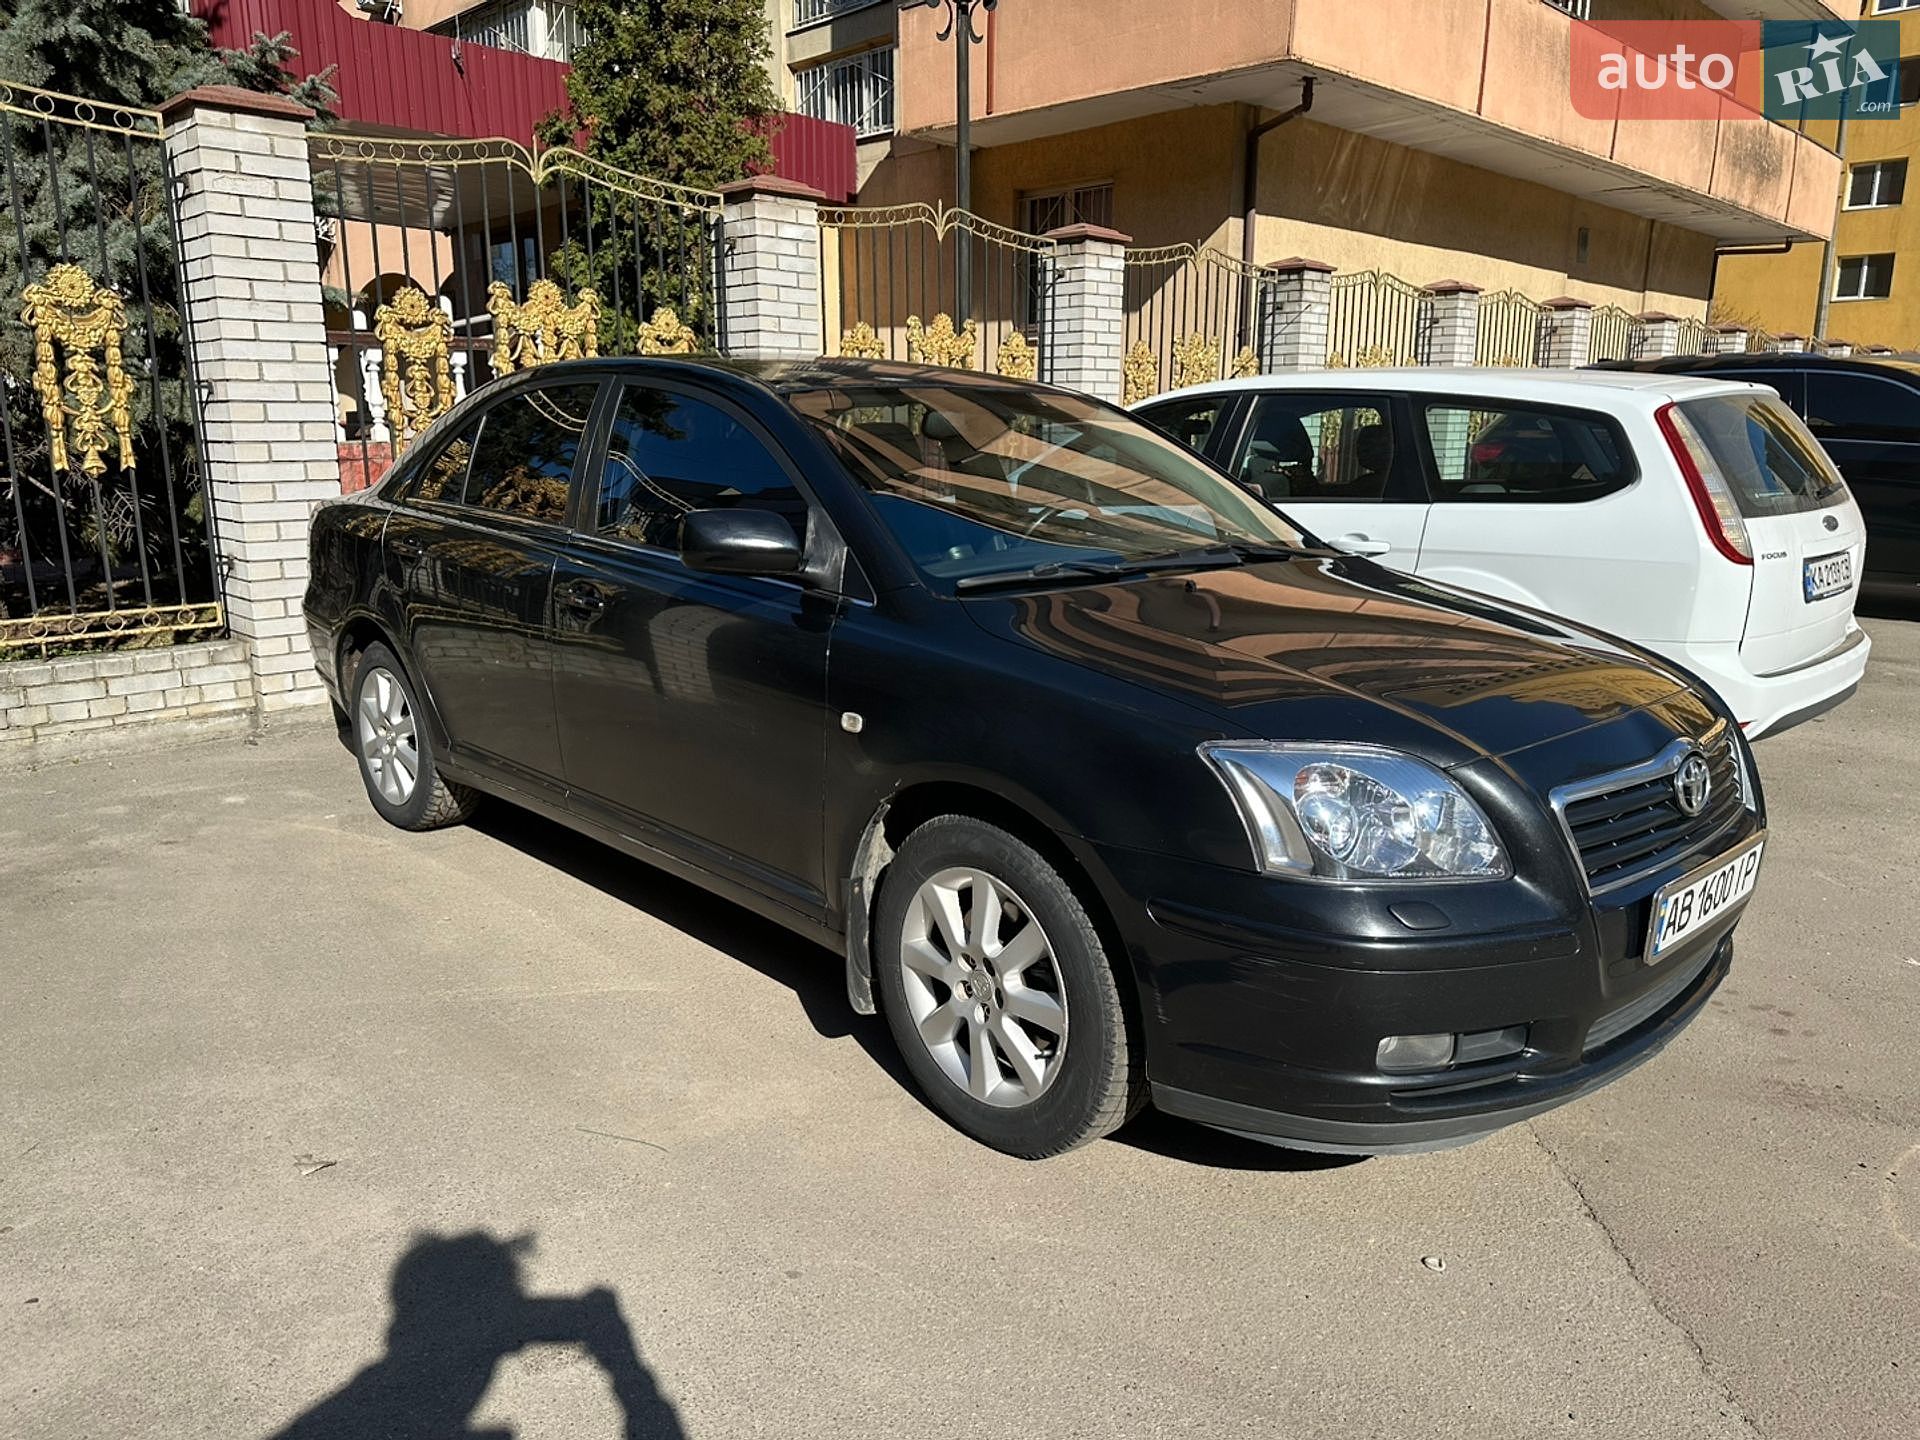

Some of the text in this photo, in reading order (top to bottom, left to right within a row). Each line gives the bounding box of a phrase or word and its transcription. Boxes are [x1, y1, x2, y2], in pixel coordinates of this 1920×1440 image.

[1761, 551, 1788, 560] FOCUS
[1662, 850, 1757, 941] AB 1600 IP
